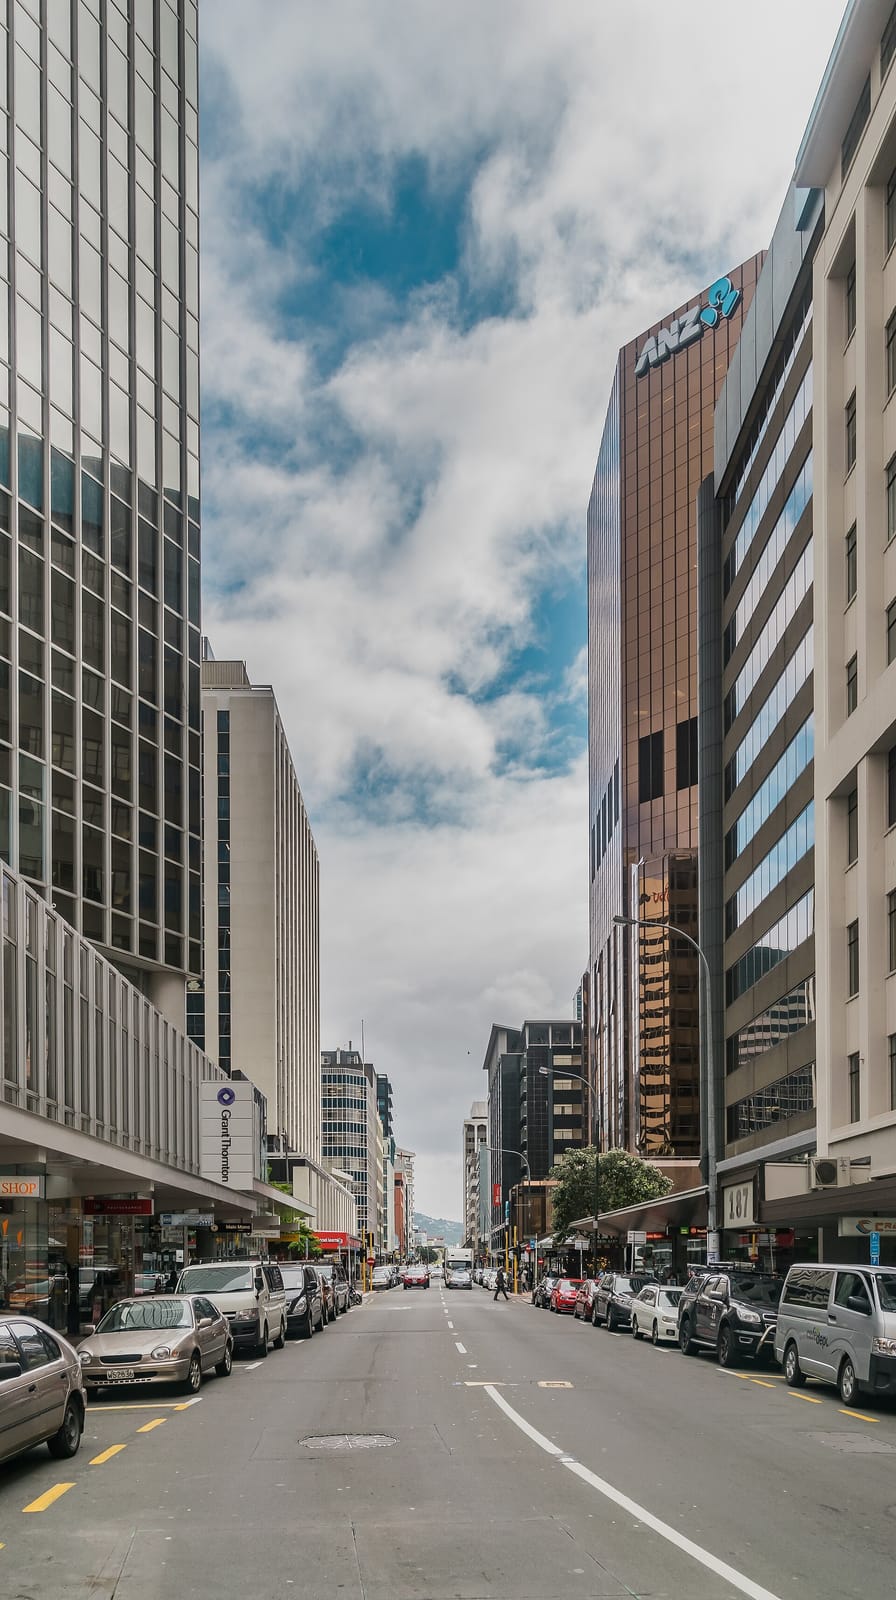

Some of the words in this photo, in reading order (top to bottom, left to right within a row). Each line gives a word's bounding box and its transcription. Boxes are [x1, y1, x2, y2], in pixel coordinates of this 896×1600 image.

[634, 304, 703, 377] ANZ
[221, 1109, 231, 1137] Grant
[221, 1138, 231, 1182] Thornton
[1, 1182, 37, 1194] SHOP
[729, 1187, 748, 1220] 187
